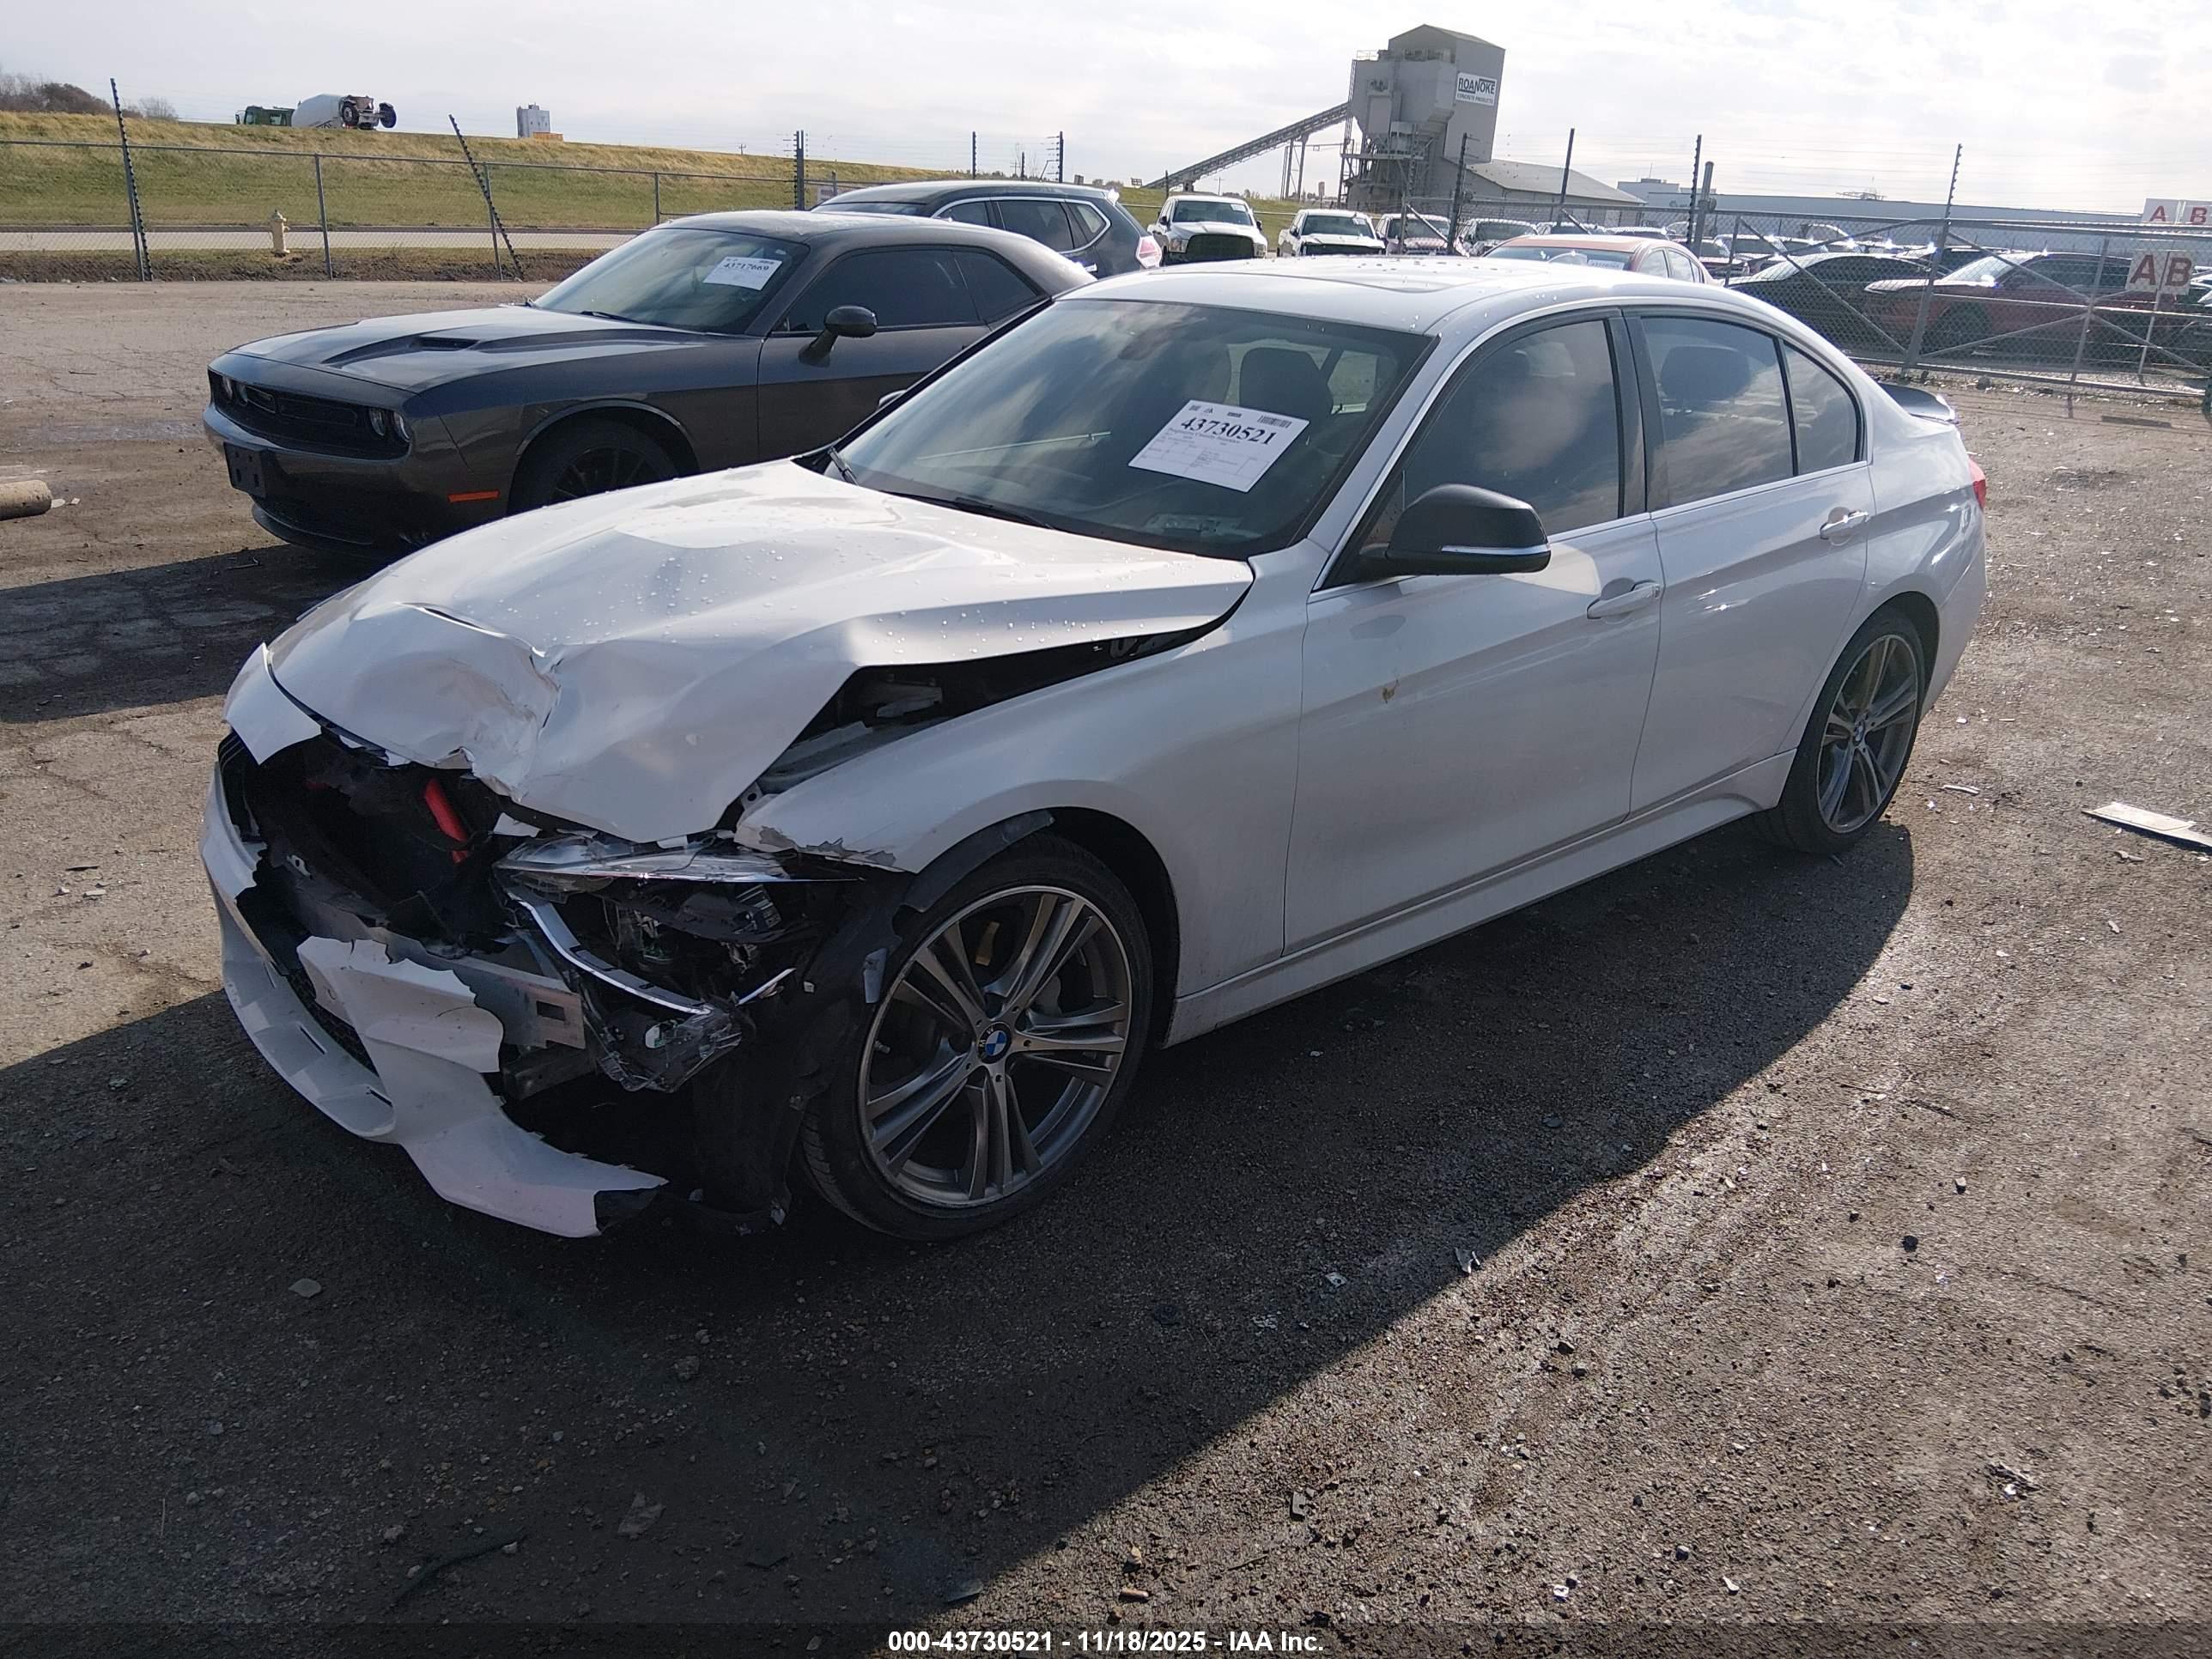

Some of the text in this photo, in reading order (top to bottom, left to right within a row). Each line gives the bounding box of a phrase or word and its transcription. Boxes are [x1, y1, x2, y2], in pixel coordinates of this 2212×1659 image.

[1458, 77, 1495, 94] ROANOKE
[1456, 92, 1474, 101] CONCRETE
[2149, 205, 2207, 224] A B
[2130, 254, 2192, 287] A B
[1181, 416, 1277, 446] 43730521
